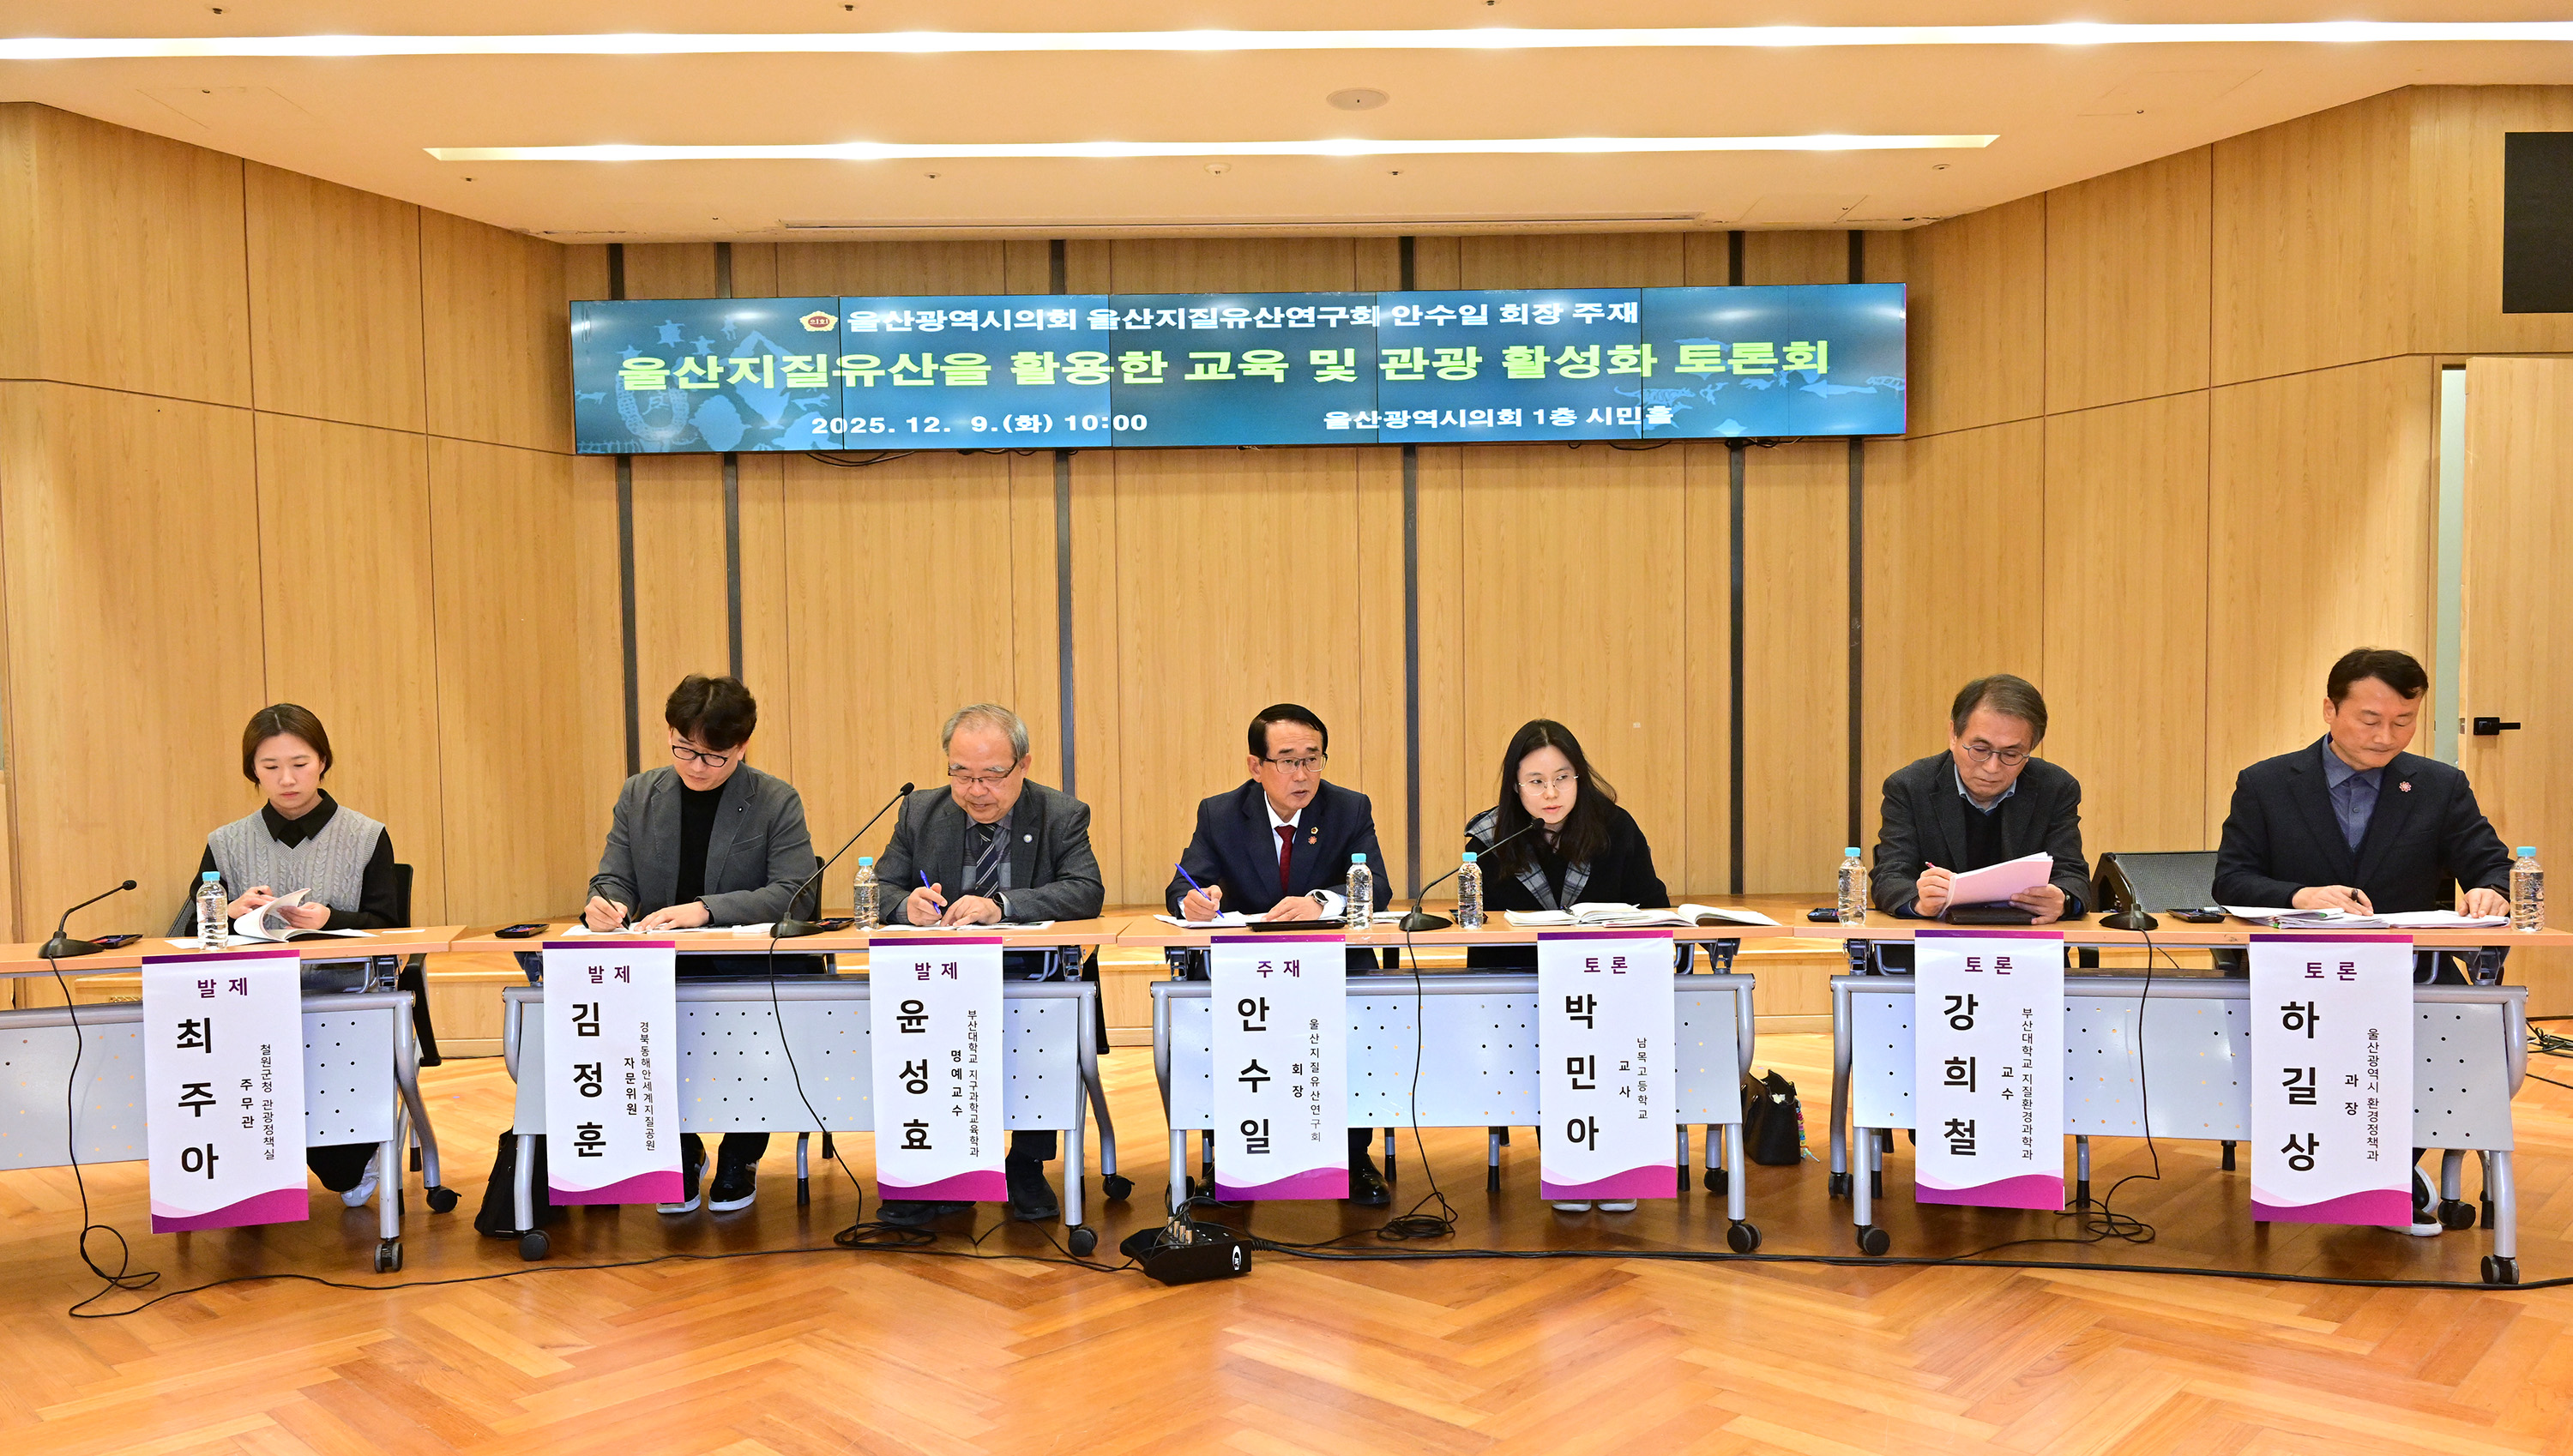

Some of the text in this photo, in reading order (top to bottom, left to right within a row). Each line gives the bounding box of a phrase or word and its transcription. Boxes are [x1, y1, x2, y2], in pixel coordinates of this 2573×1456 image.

[847, 302, 1638, 333] 울산광역시의회 울산지질유산연구회 안수일 회장 주재
[619, 340, 1829, 391] 울산지질유산을 활용한 교육 및 관광 활성화 토론회
[811, 413, 1148, 434] 2025. 12. 9.(화) 10:00
[1323, 406, 1674, 430] 울산광역시의회 1층 시민홀
[197, 977, 248, 999] 발제
[588, 965, 630, 984] 발제
[914, 961, 958, 981] 발제
[1256, 959, 1300, 978] 주재
[1583, 956, 1628, 975] 토론
[1964, 956, 2013, 975] 토론
[2304, 961, 2358, 981] 토론
[176, 1017, 220, 1180] 최주아
[571, 1002, 606, 1158] 김정훈
[624, 1056, 637, 1116] 자문위원
[640, 1021, 655, 1152] 경북동해안세계지질공원
[895, 999, 932, 1150] 윤성효
[950, 1050, 963, 1117] 명예교수
[967, 1009, 979, 1158] 부산대학교 지구과학교육학과
[1238, 996, 1271, 1155] 안수일
[1292, 1062, 1304, 1098] 회장
[1309, 1019, 1321, 1142] 울산지질유산연구회
[1565, 993, 1600, 1152] 박민아
[1618, 1060, 1631, 1098] 교사
[1636, 1037, 1648, 1119] 남목고등학교
[1943, 993, 1979, 1157] 강희철
[2001, 1066, 2015, 1101] 교수
[2022, 1008, 2034, 1161] 부산대학교 지질환경과학과
[2280, 1001, 2320, 1172] 하길상
[2344, 1074, 2359, 1116] 과장
[2366, 1028, 2380, 1162] 울산광역시 환경정책과
[239, 1078, 255, 1129] 주무관
[260, 1044, 274, 1160] 철원군청 관광정책실
